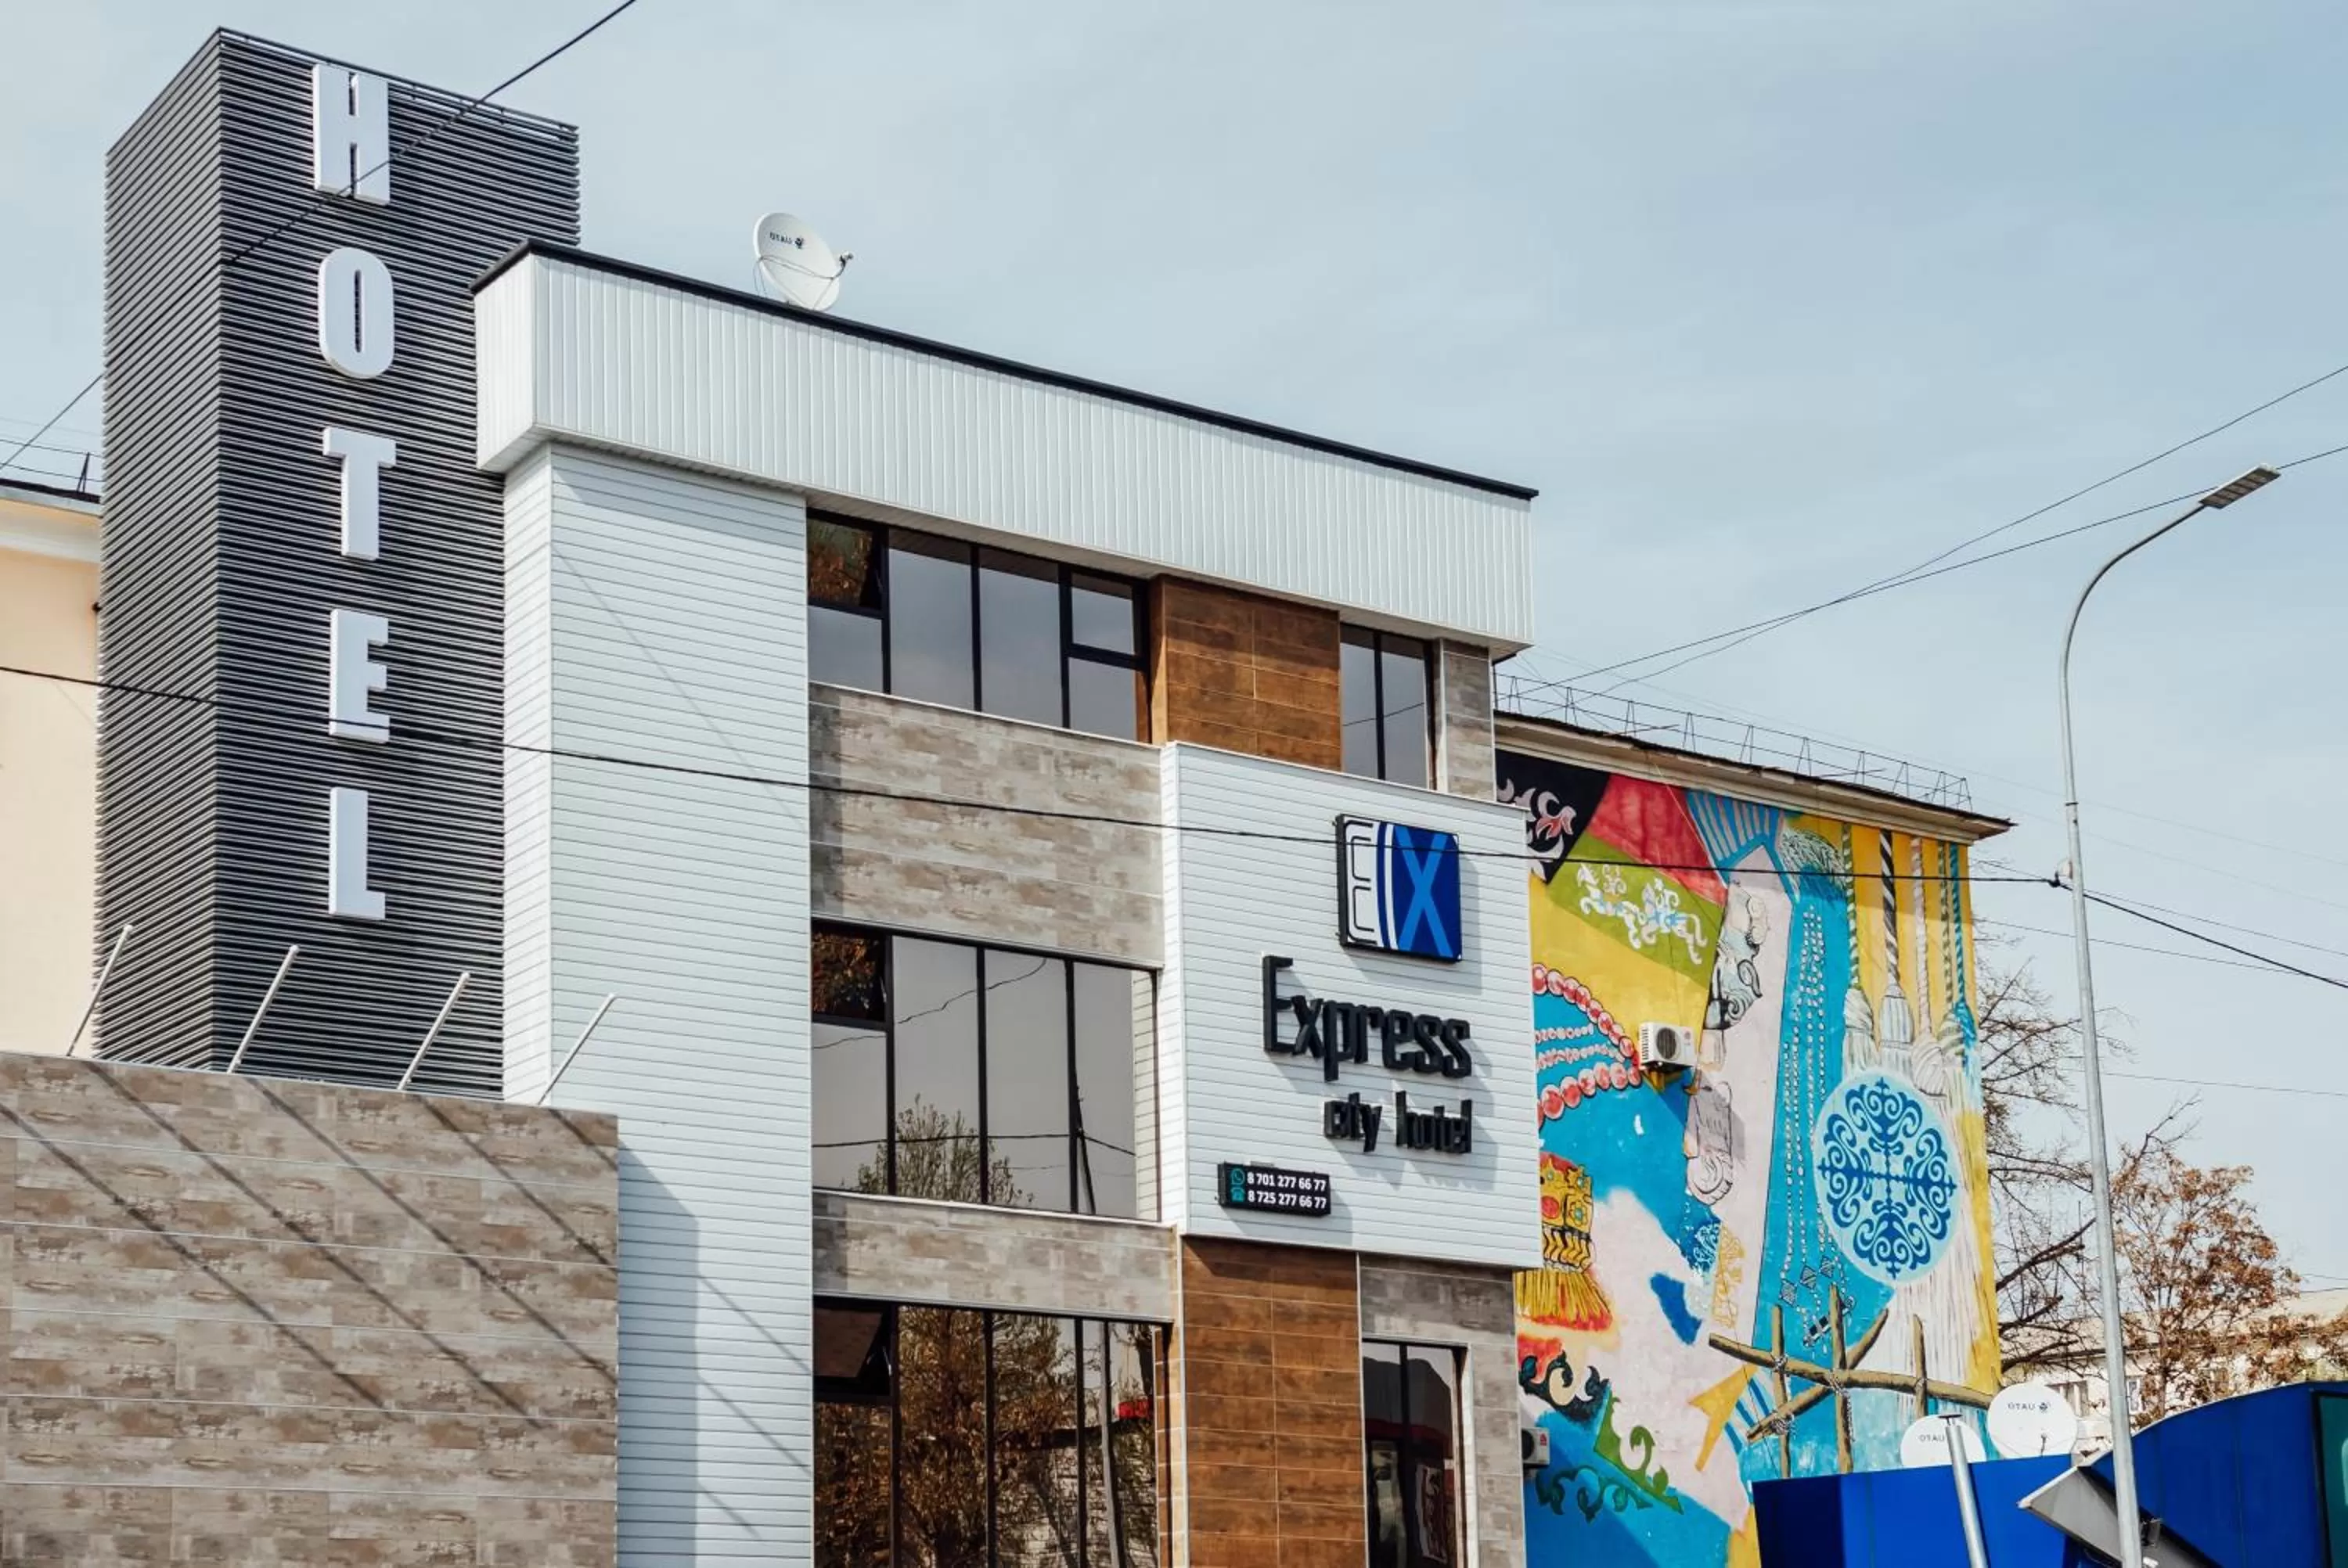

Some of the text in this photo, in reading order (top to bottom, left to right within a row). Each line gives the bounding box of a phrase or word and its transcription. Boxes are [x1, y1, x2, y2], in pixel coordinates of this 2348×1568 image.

[313, 63, 397, 920] HOTEL
[1262, 955, 1471, 1081] Express
[1323, 1091, 1472, 1153] city hotel
[1247, 1172, 1327, 1191] 8 701 277 66 77
[1248, 1190, 1327, 1209] 8 725 277 66 77
